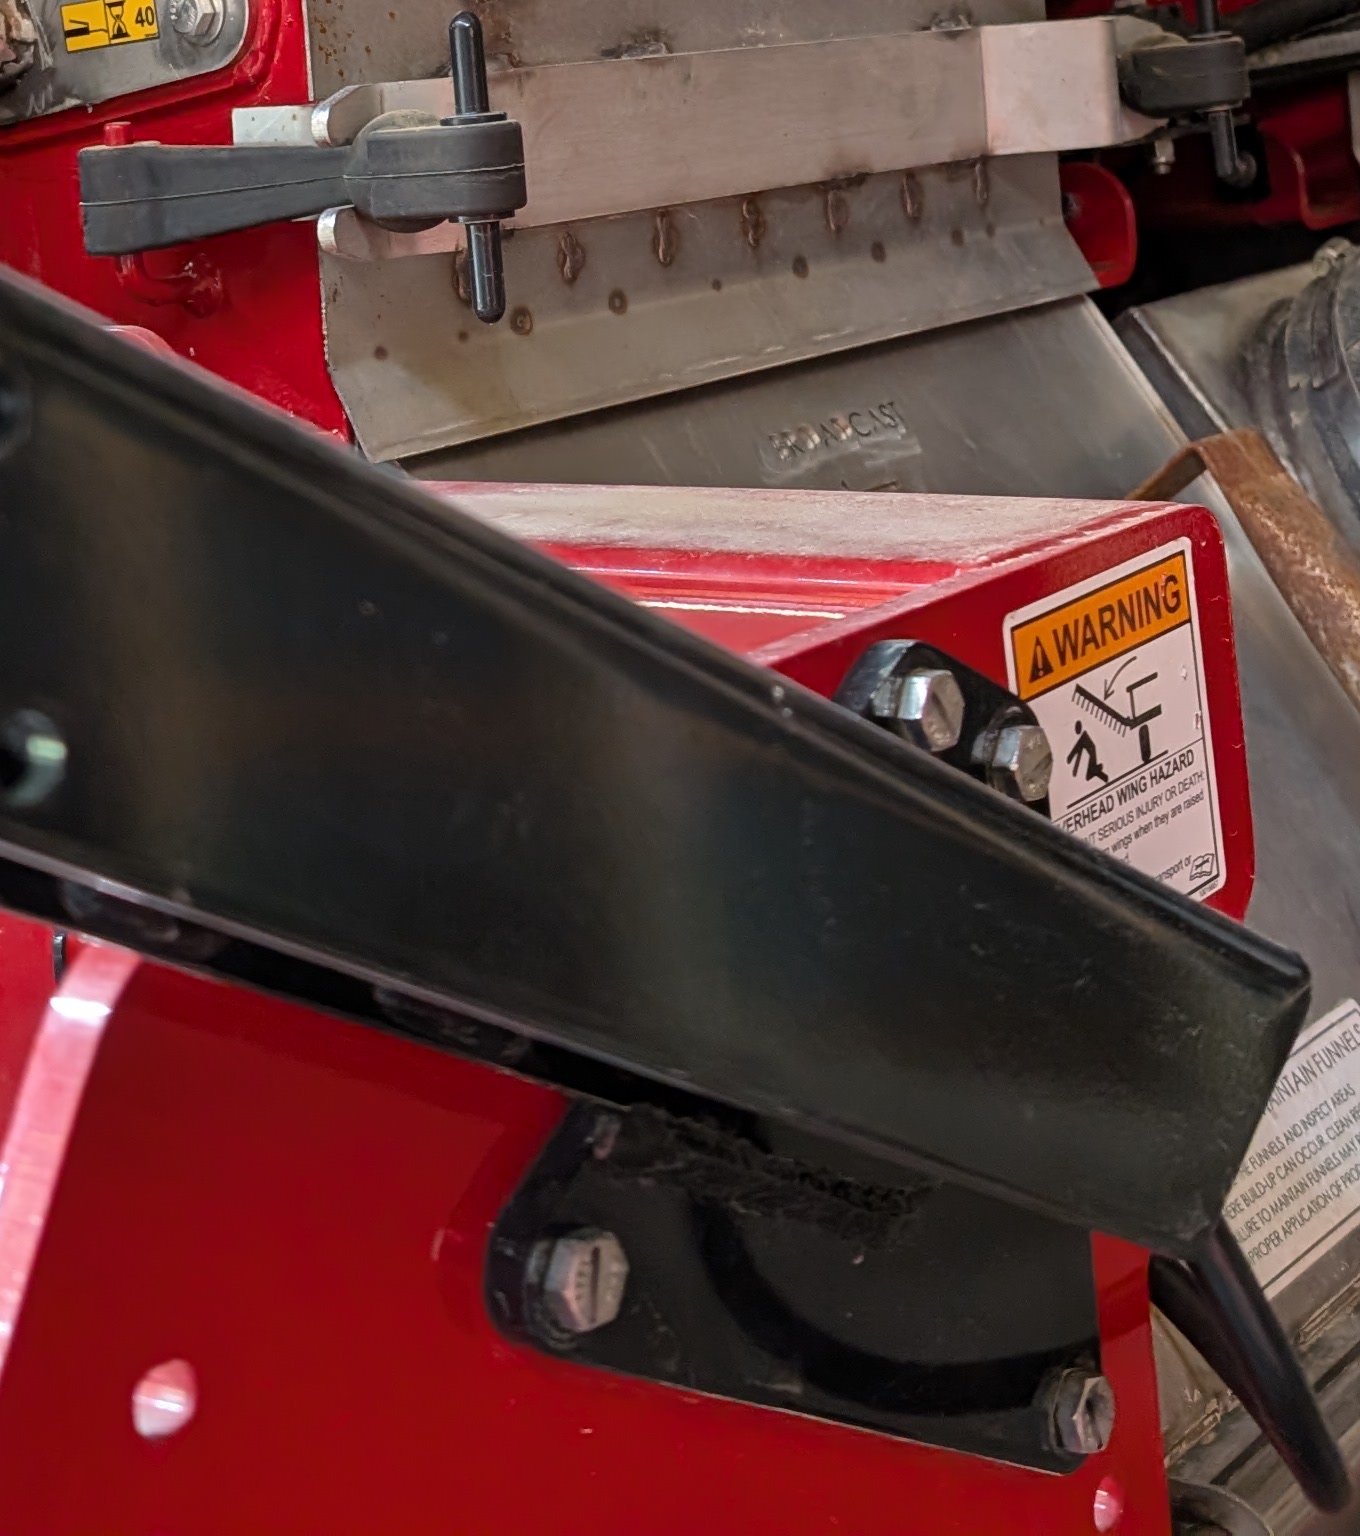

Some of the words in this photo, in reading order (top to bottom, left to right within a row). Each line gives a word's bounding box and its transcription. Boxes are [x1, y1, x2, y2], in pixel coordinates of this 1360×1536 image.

[135, 6, 155, 28] 40
[1052, 574, 1181, 667] WARNING
[1116, 776, 1148, 806] WING
[1150, 749, 1195, 787] HAZARD
[1098, 810, 1134, 840] SERIOUS
[1135, 793, 1165, 818] INJURY
[1165, 784, 1178, 802] OR
[1111, 833, 1133, 852] wings
[1134, 820, 1153, 839] when
[1153, 812, 1169, 830] they
[1170, 804, 1182, 819] are
[1182, 788, 1205, 812] raised
[1184, 855, 1192, 867] or
[1248, 1135, 1286, 1171] FUNNELS
[1283, 1122, 1303, 1146] AND
[1300, 1100, 1332, 1131] INSPECT
[1329, 1083, 1356, 1110] AREAS
[1241, 1170, 1277, 1207] BUILD-UP
[1276, 1157, 1298, 1180] CAN
[1325, 1113, 1353, 1140] CLEAN
[1257, 1207, 1272, 1226] TO
[1269, 1176, 1311, 1216] MAINTAIN
[1305, 1152, 1341, 1187] FUNNELS
[1337, 1137, 1359, 1162] MAY
[1281, 1187, 1334, 1240] APPLICATION
[1330, 1179, 1344, 1197] OF
